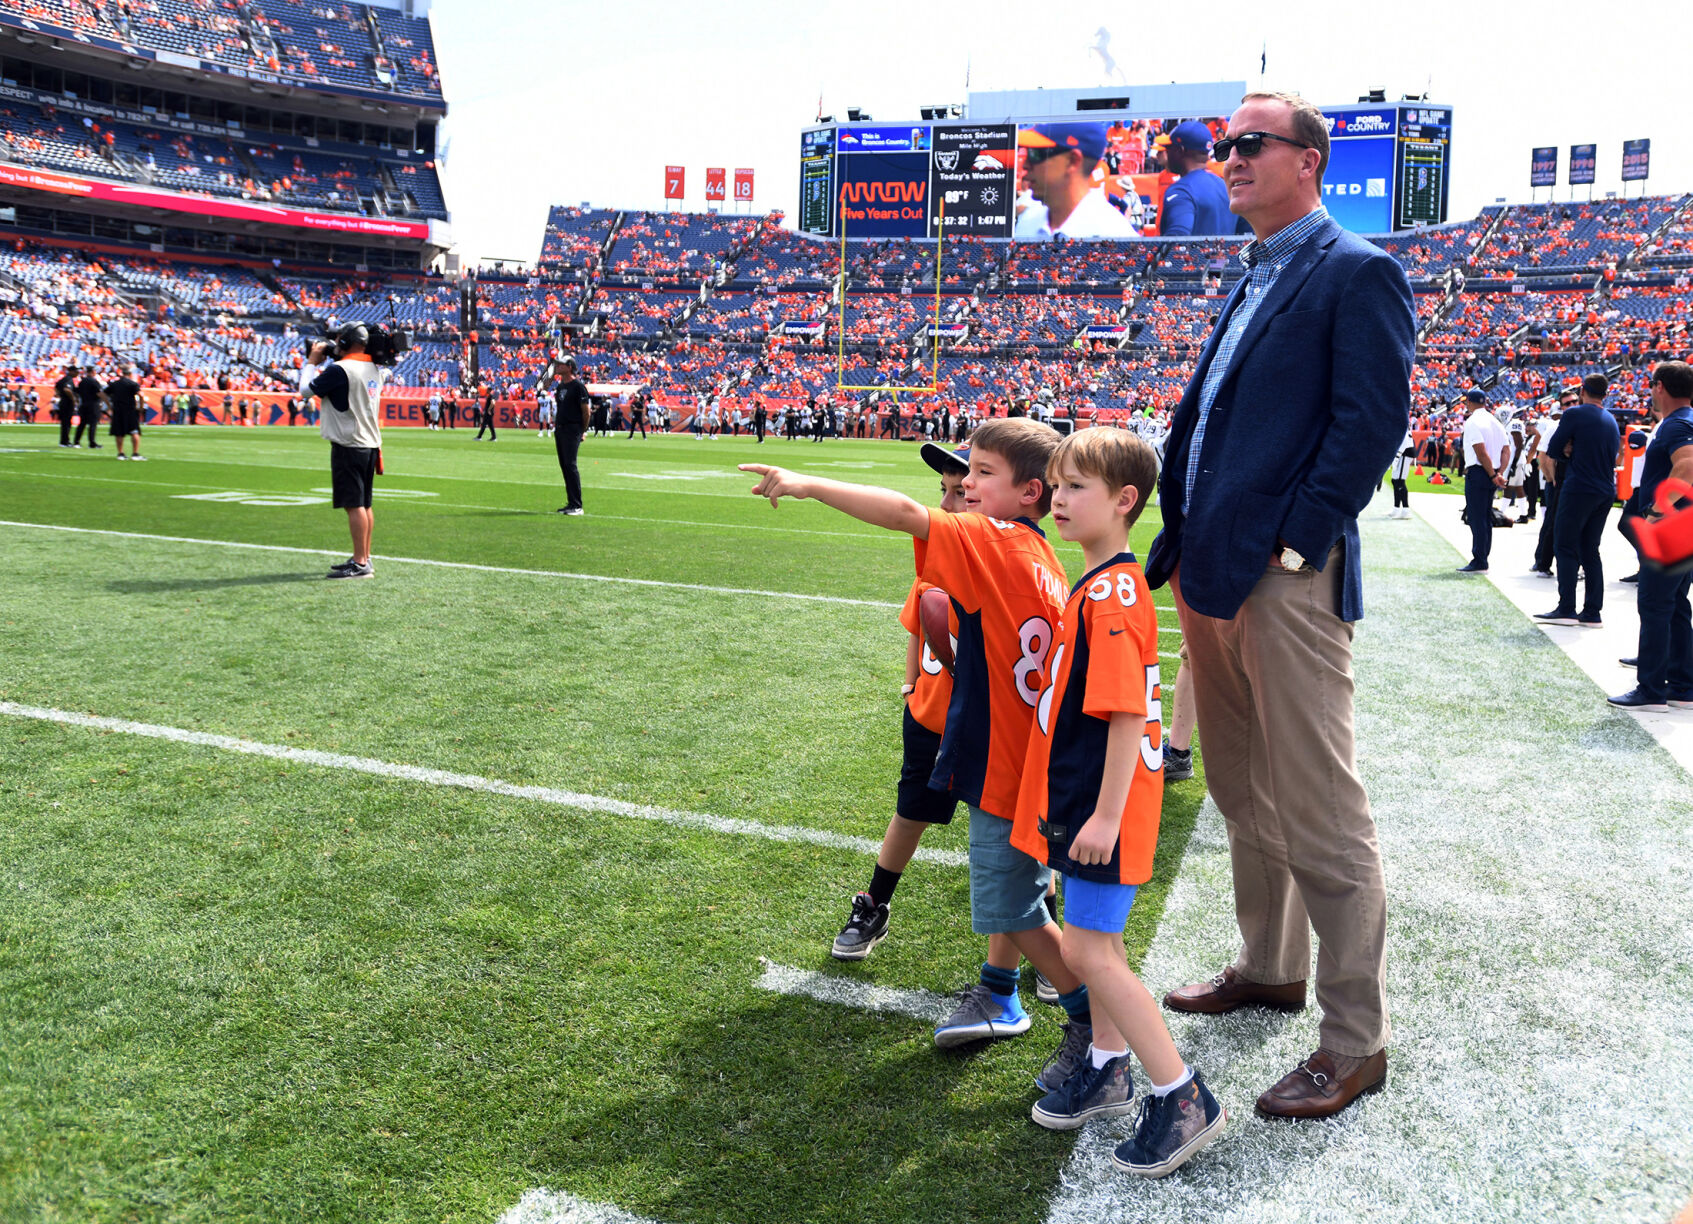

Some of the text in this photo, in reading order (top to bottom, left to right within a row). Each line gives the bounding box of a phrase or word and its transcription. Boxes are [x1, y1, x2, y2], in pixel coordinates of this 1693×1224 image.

[1355, 115, 1382, 124] FORD
[1347, 122, 1390, 132] COUNTRY
[940, 131, 1008, 140] Broncos Stadium
[1623, 153, 1648, 165] 2015
[1533, 161, 1555, 171] 1997
[940, 172, 1006, 181] Today's Weather
[669, 179, 680, 194] 7
[706, 181, 725, 196] 44
[736, 181, 751, 196] 18
[839, 181, 926, 202] ARROW
[840, 206, 923, 219] Five Years Out
[500, 407, 541, 424] 580
[1087, 572, 1137, 607] 58
